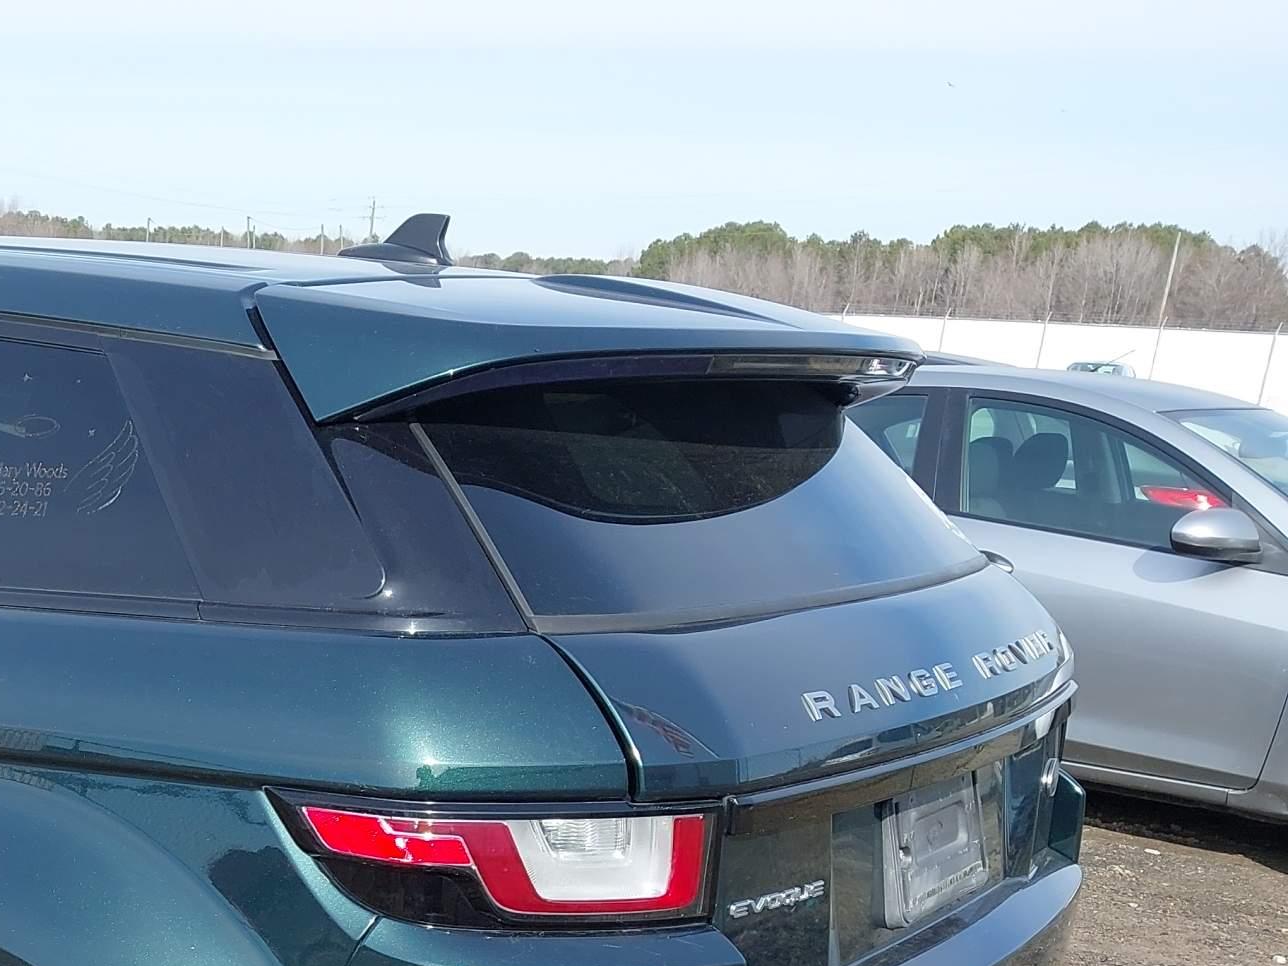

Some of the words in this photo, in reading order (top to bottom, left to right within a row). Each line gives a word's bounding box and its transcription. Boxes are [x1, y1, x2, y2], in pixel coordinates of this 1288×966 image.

[25, 462, 69, 479] Woods
[800, 662, 965, 723] RANGE
[971, 629, 1055, 680] ROVER
[728, 879, 826, 920] EVOQUE
